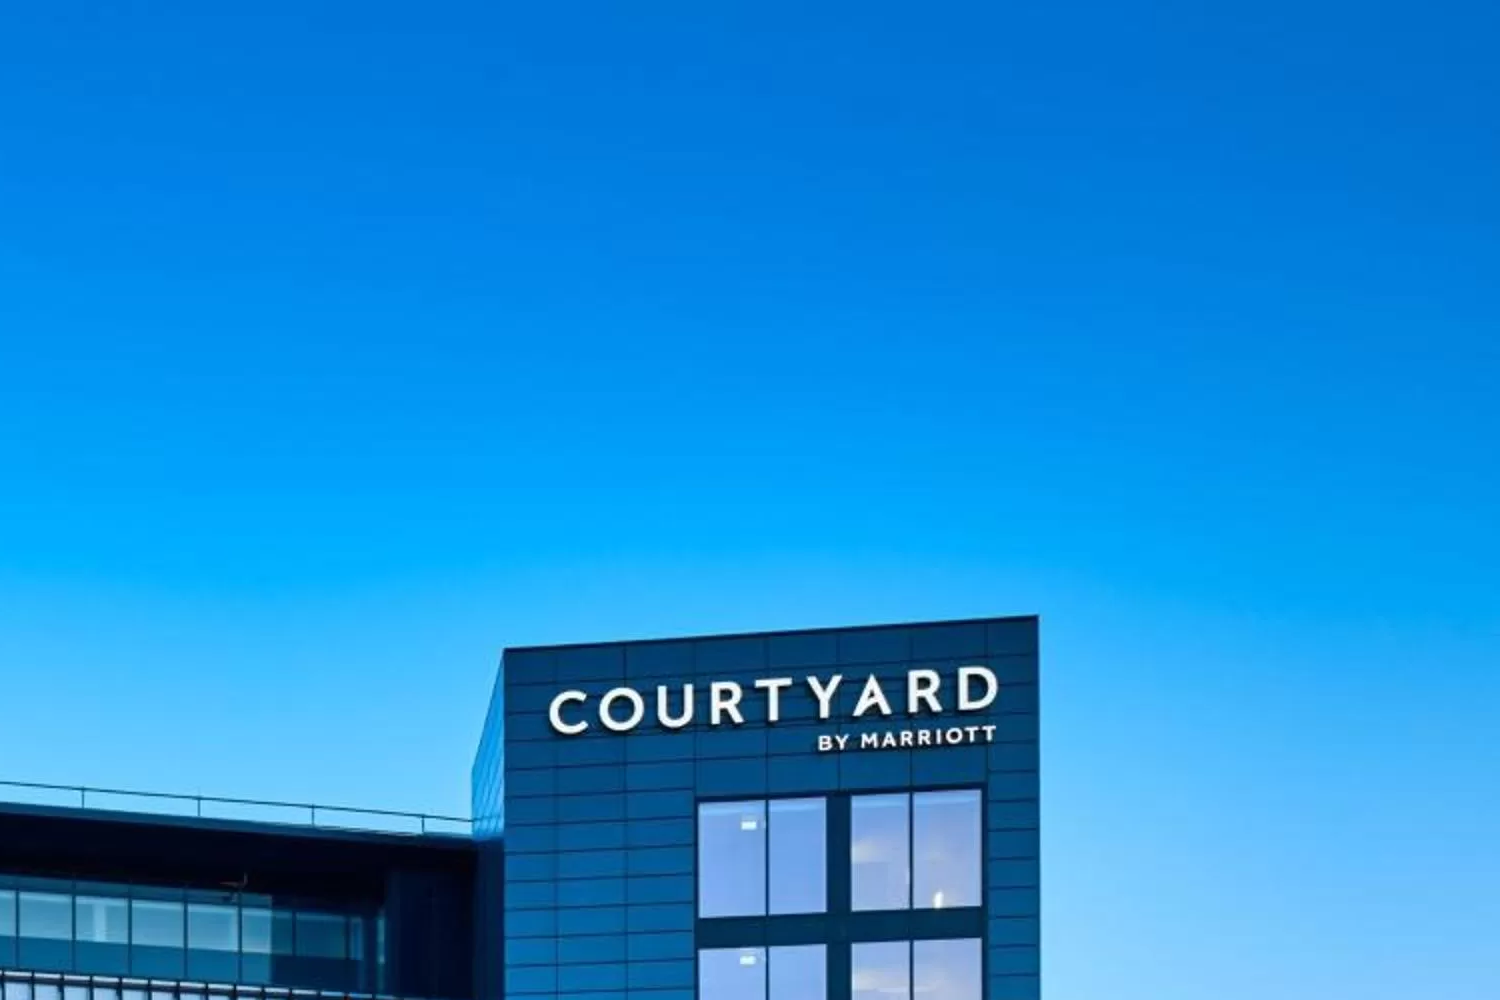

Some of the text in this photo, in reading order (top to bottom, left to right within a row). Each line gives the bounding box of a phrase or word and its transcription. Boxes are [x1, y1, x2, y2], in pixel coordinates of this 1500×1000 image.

[548, 666, 998, 735] COURTYARD
[817, 725, 997, 751] BY MARRIOTT
